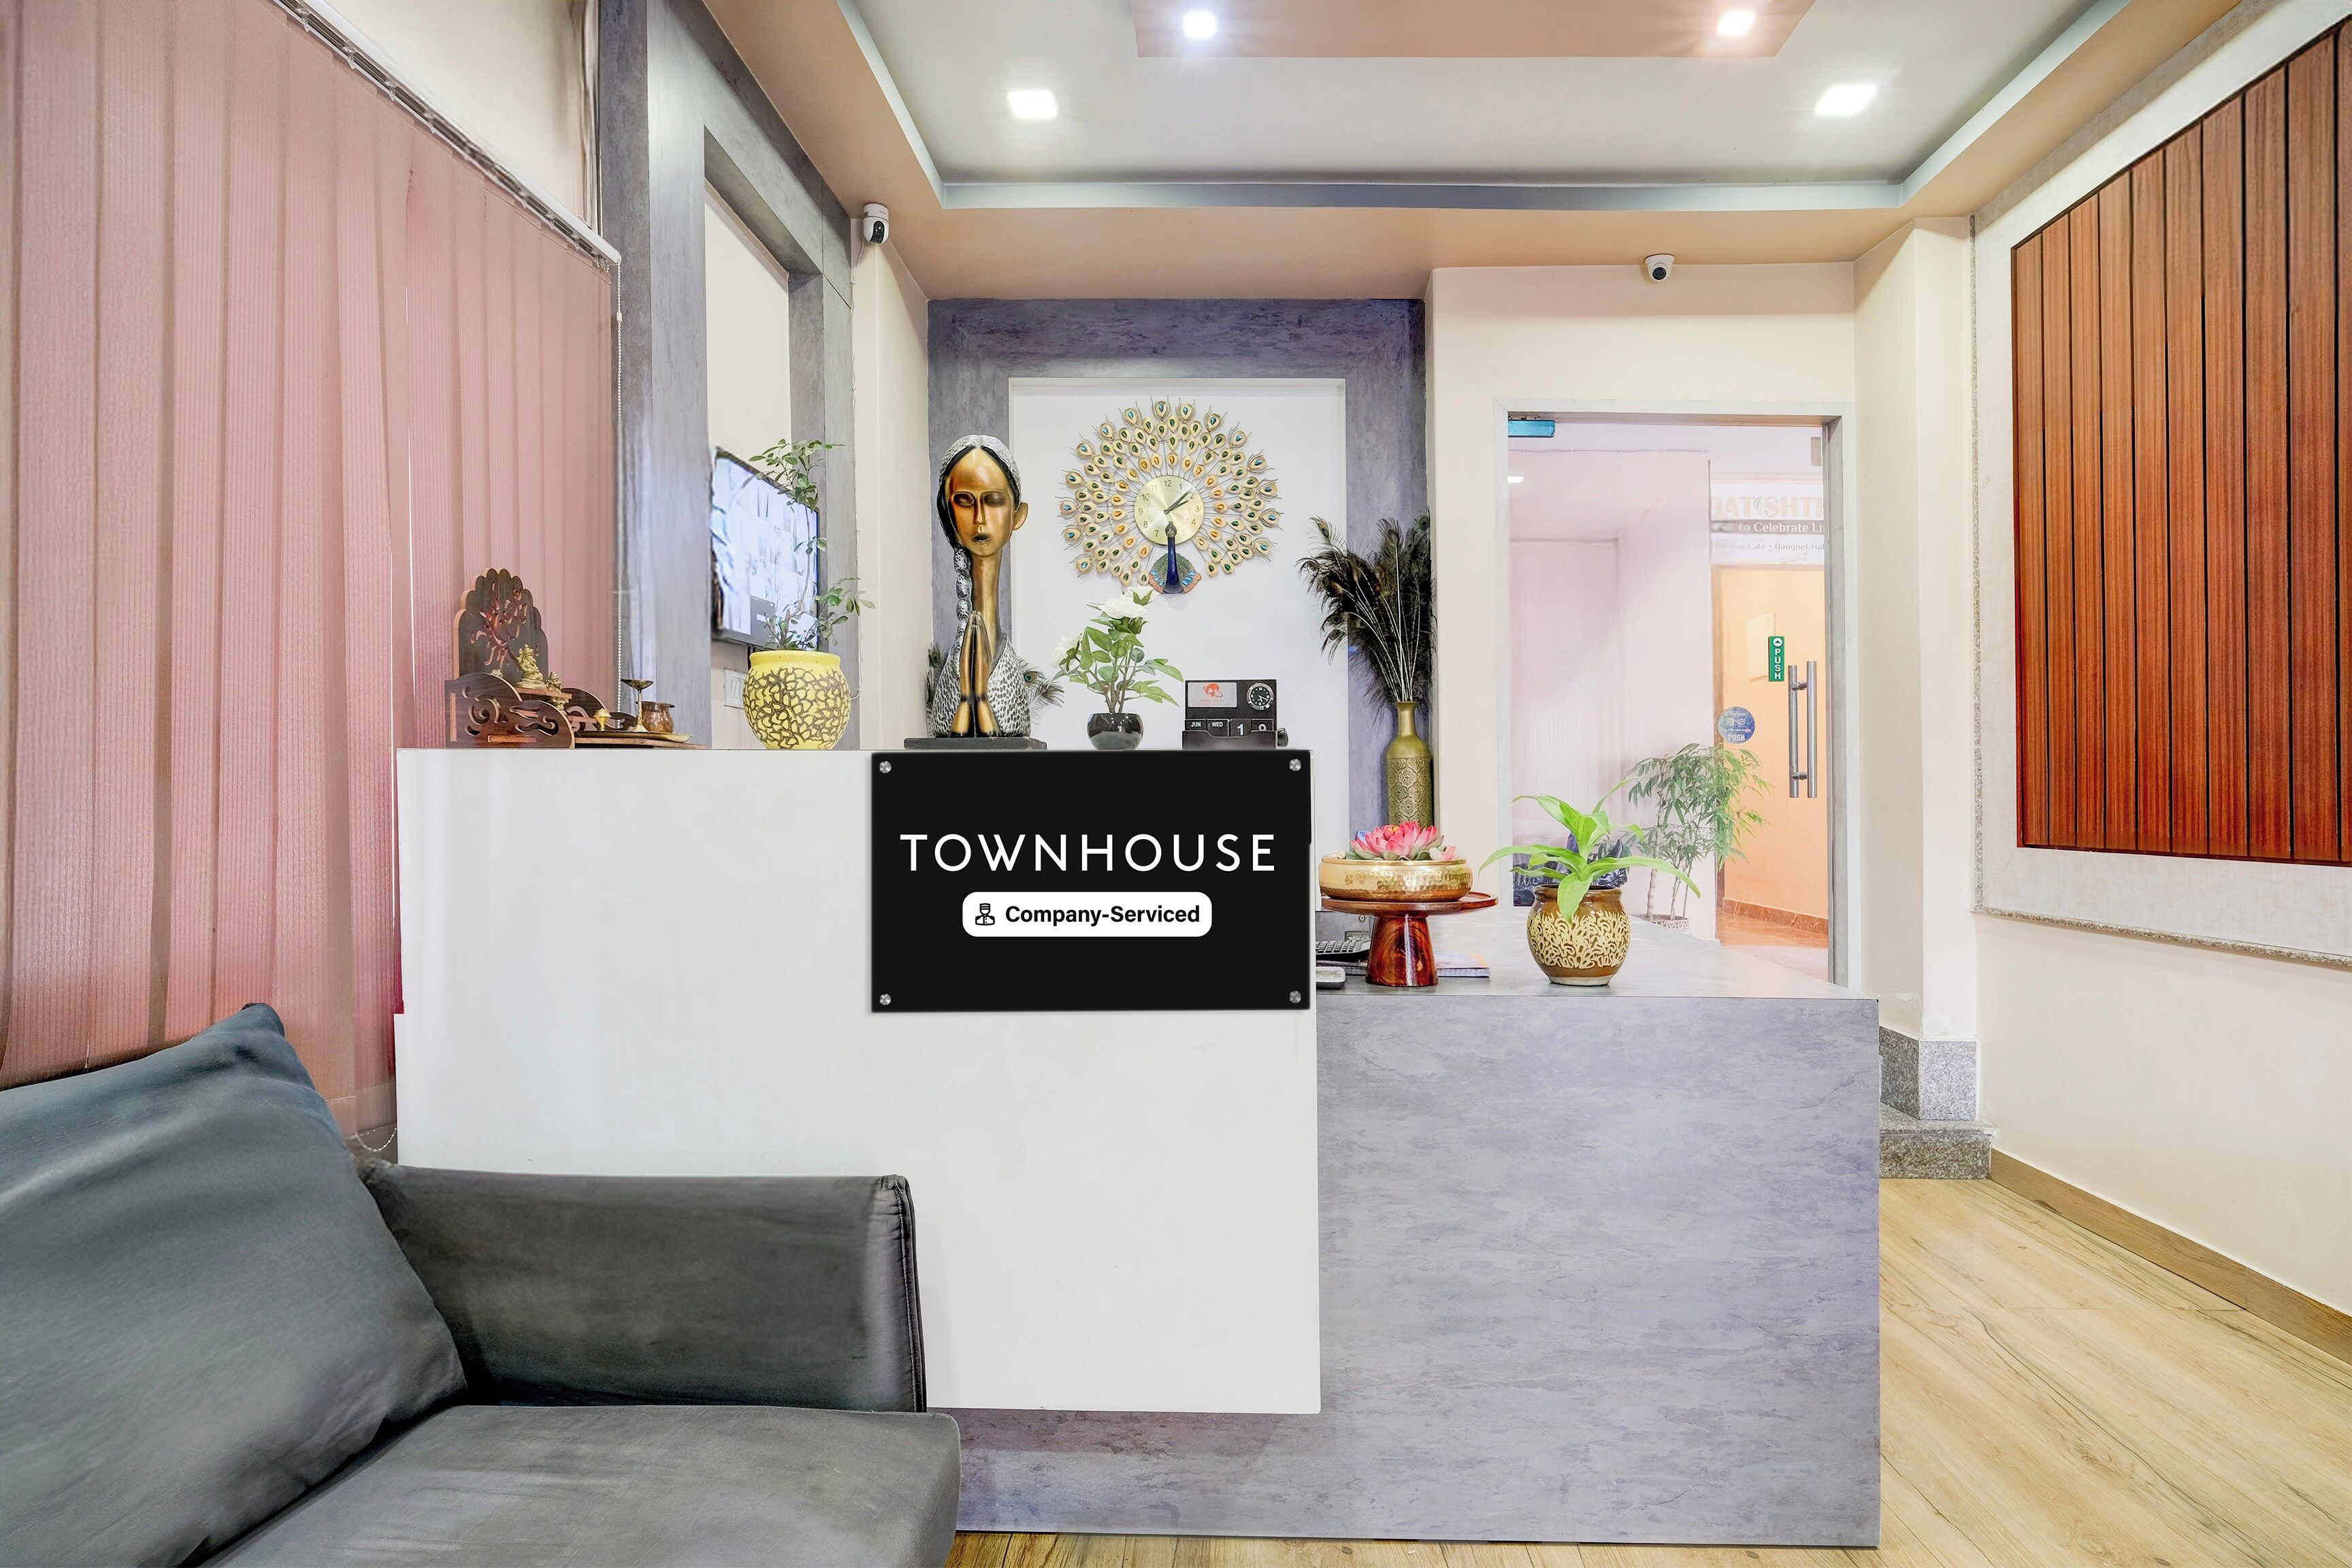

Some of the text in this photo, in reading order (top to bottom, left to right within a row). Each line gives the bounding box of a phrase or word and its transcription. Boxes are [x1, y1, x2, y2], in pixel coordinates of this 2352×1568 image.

[1754, 522, 1810, 532] Celebrate
[1237, 723, 1244, 736] 1
[900, 834, 1275, 872] TOWNHOUSE
[1005, 904, 1200, 926] Company-Serviced
